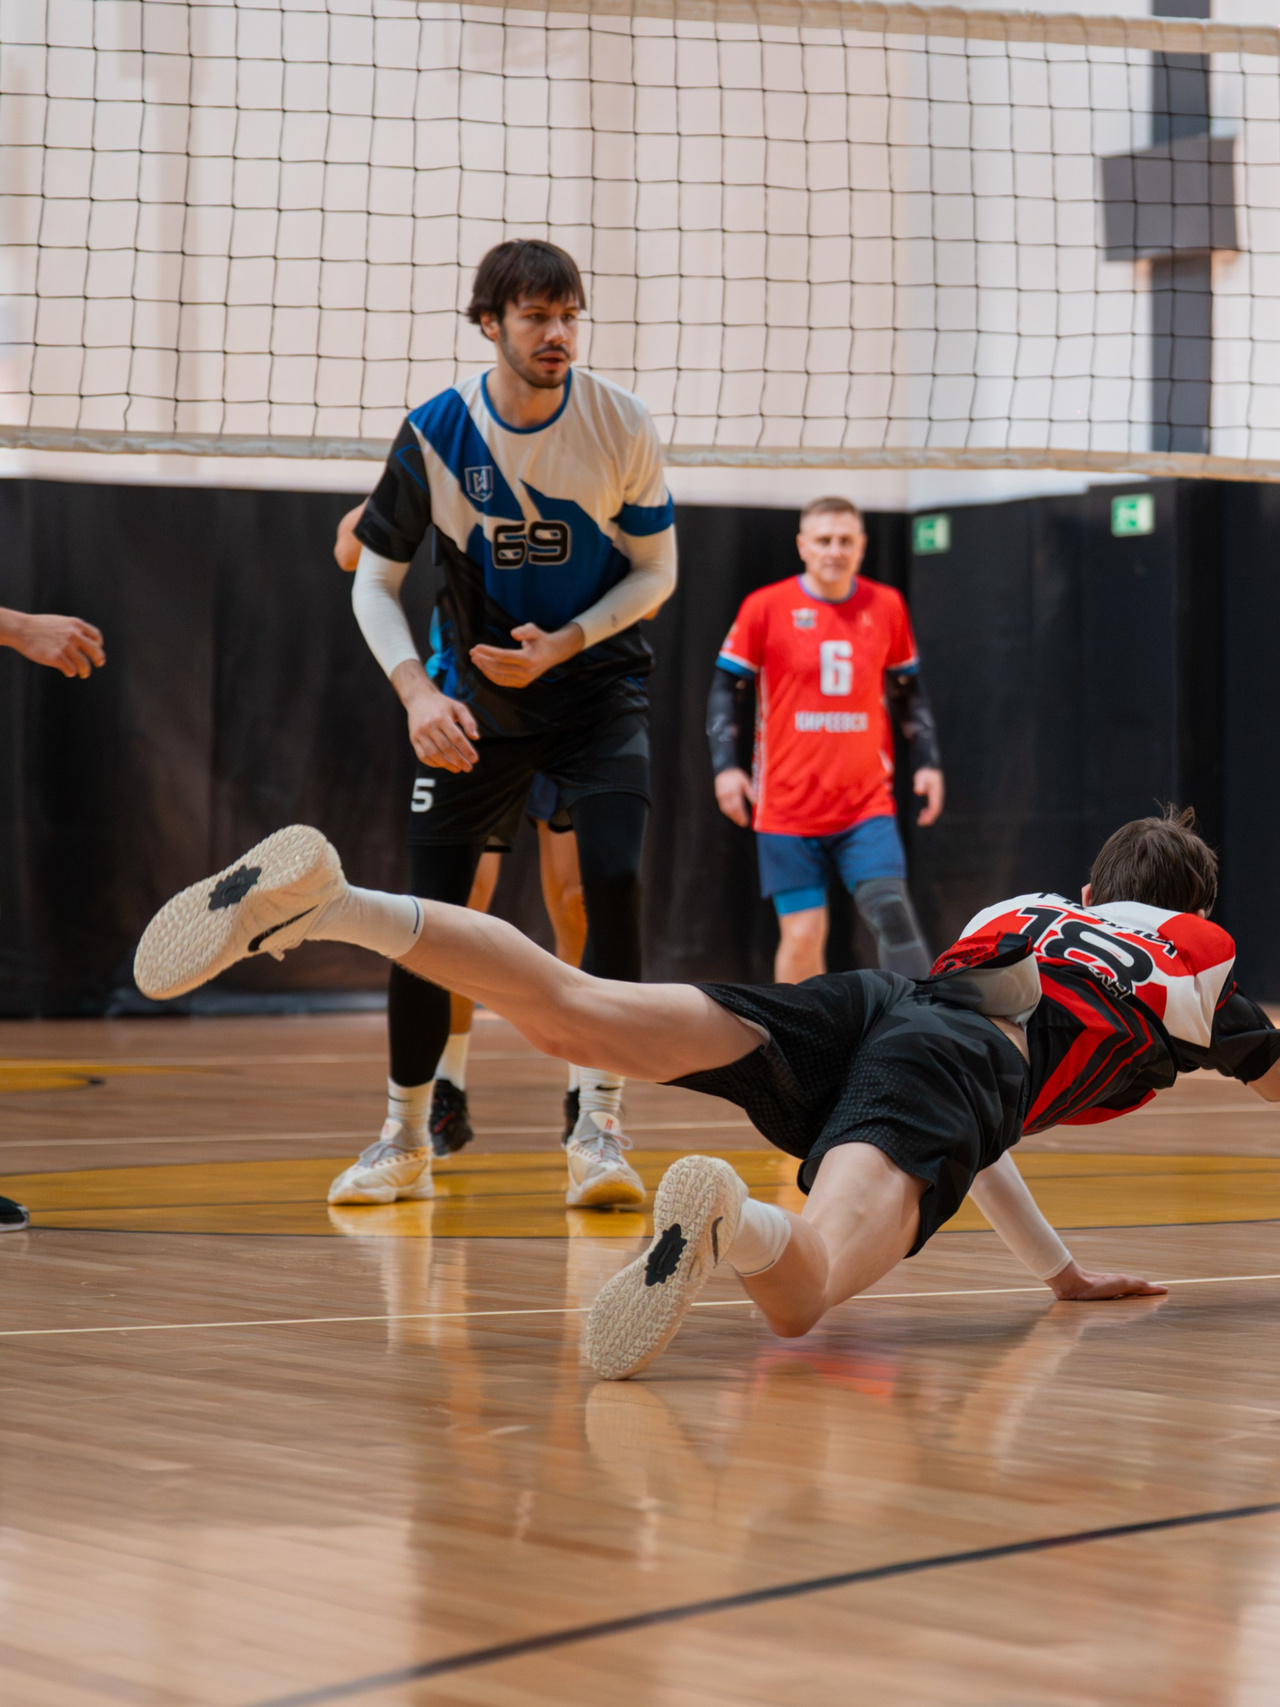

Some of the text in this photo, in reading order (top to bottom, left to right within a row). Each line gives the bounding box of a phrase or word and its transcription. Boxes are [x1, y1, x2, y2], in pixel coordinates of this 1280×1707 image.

[492, 519, 572, 569] 69
[820, 640, 853, 697] 6
[411, 778, 436, 813] 5
[1016, 905, 1155, 988] 18
